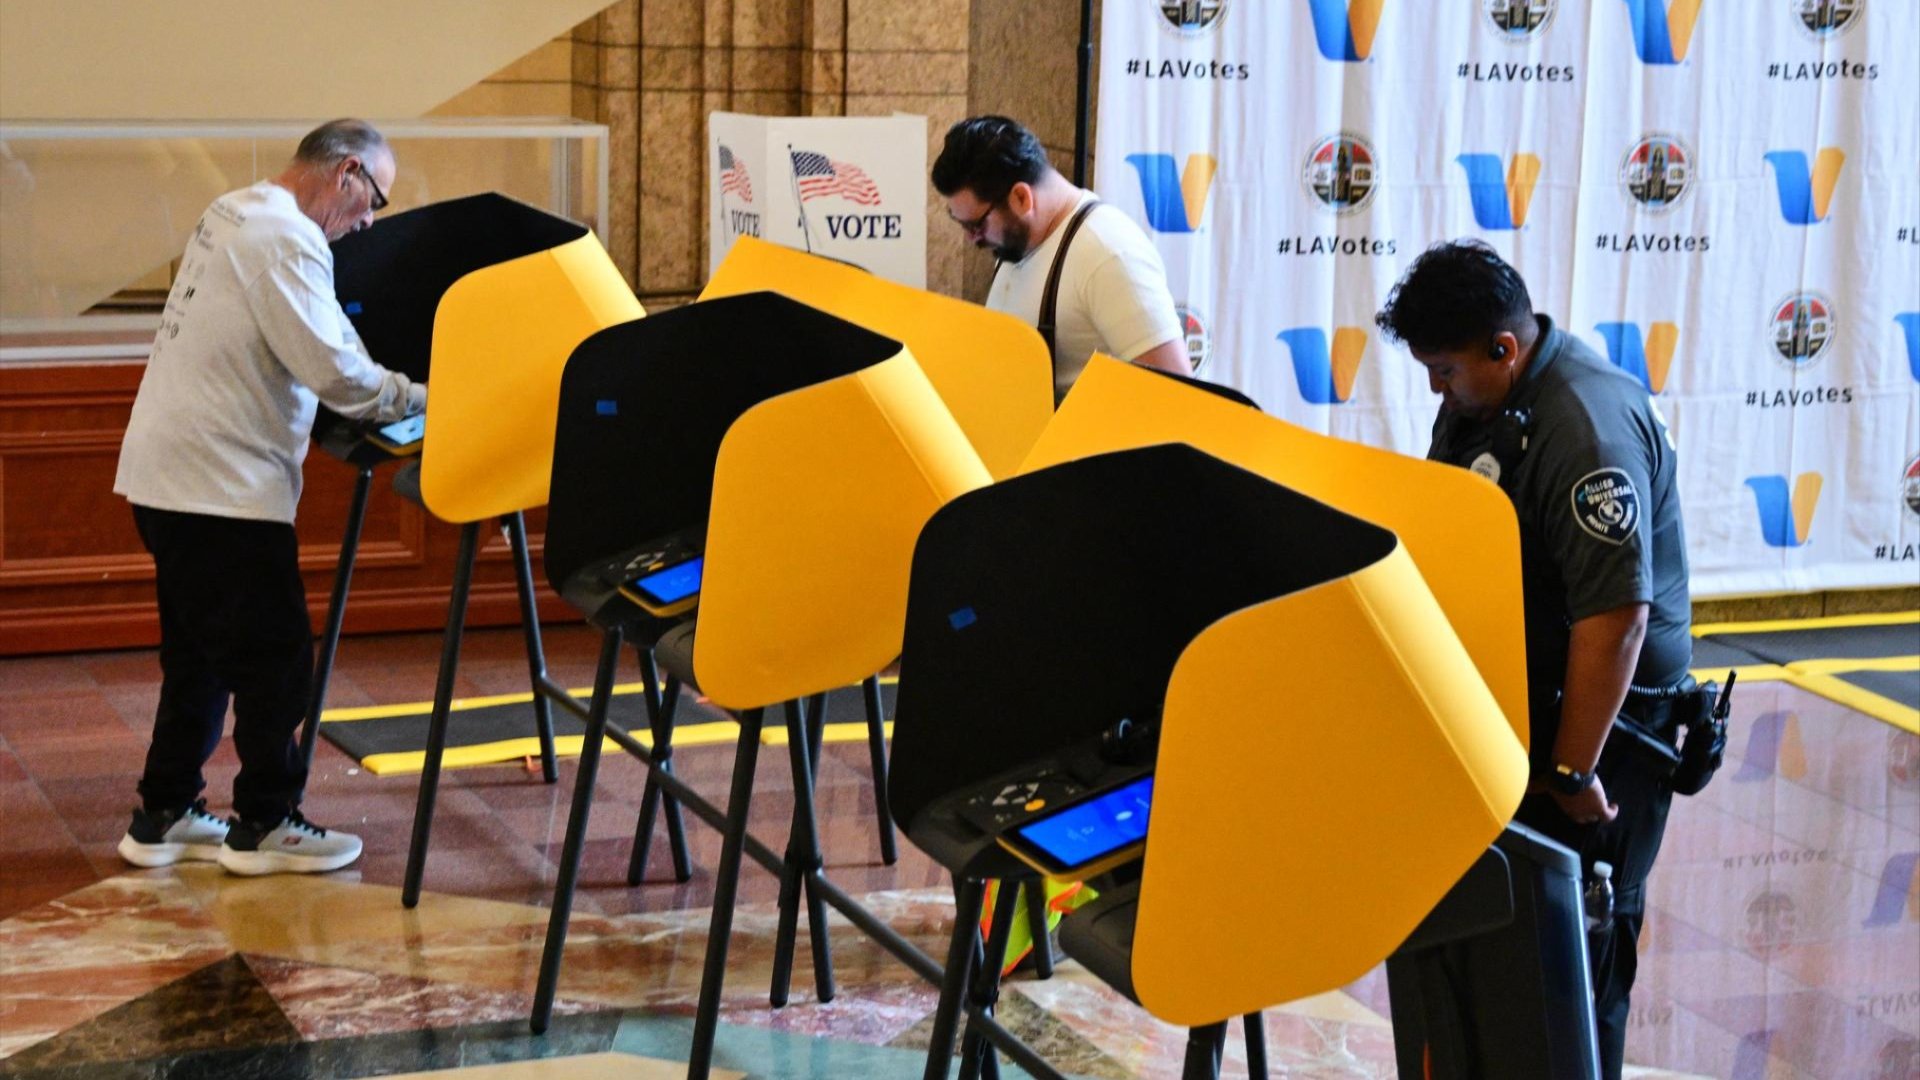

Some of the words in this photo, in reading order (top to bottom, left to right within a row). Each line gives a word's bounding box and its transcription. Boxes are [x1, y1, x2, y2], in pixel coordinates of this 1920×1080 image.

[1127, 58, 1249, 80] #LAVotes
[1457, 62, 1574, 81] #LAVotes
[1767, 58, 1878, 80] #LAVotes
[731, 210, 760, 237] VOTE
[826, 215, 901, 239] VOTE
[1278, 235, 1396, 255] #LAVotes
[1597, 234, 1709, 252] #LAVotes
[1746, 386, 1852, 408] #LAVotes
